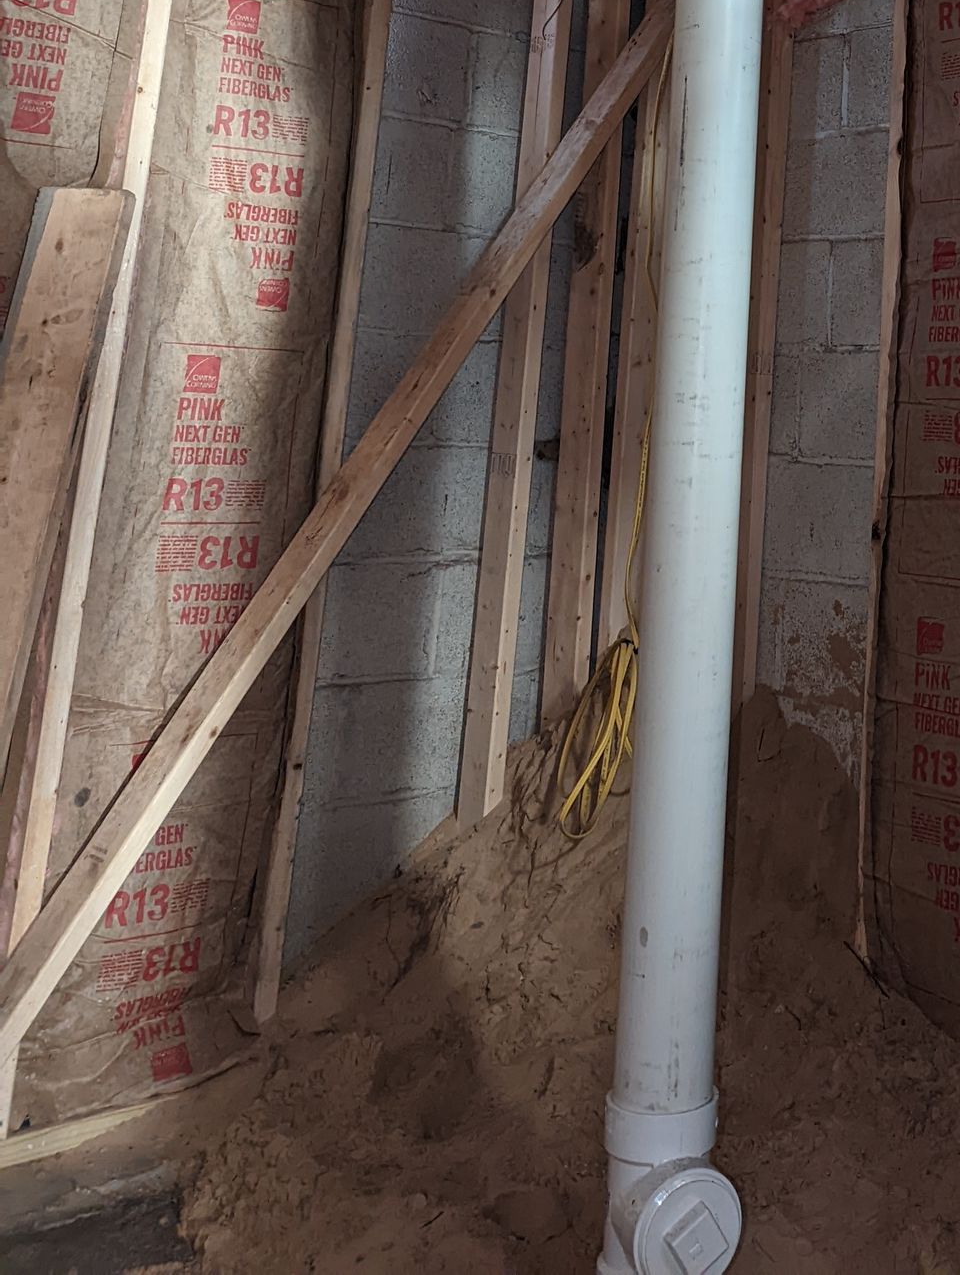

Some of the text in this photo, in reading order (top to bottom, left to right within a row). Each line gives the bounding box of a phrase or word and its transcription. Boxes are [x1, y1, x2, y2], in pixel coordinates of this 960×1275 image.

[27, 43, 67, 65] NEXT
[222, 34, 265, 60] PINK
[9, 63, 64, 92] PINK
[221, 57, 255, 77] NEXT
[218, 77, 291, 103] FIBERGLAS
[213, 104, 270, 140] R13
[249, 162, 304, 198] R13
[227, 201, 299, 225] FIBERGLAS
[263, 227, 297, 246] NEXT
[931, 304, 956, 322] NEXT
[177, 397, 225, 421] PINK
[174, 425, 210, 443] NEXT
[171, 446, 248, 466] FIBERGLAS
[162, 477, 225, 511] R13
[198, 535, 260, 570] R13
[172, 583, 254, 602] FIBERGLAS
[213, 605, 243, 625] EXT
[912, 744, 957, 788] R13
[104, 883, 170, 929] R13
[143, 937, 201, 981] R13
